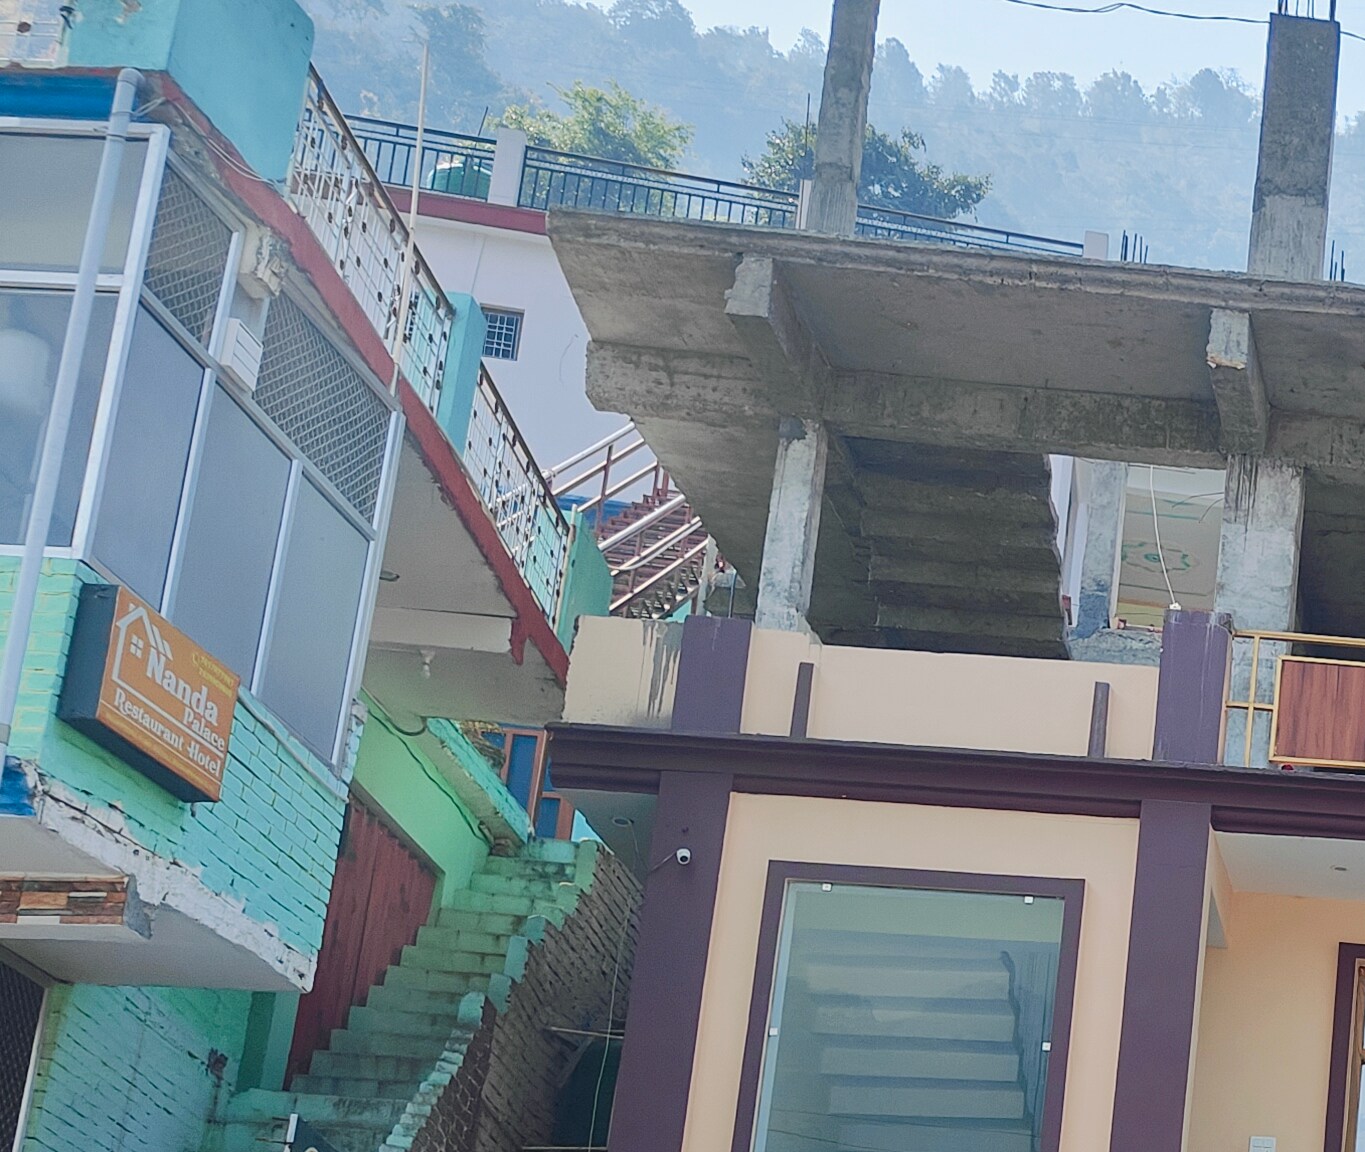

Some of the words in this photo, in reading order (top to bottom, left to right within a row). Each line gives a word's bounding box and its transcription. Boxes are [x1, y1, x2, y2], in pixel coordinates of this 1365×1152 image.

[146, 647, 218, 726] Nanda
[114, 688, 184, 751] Restaurant
[187, 741, 221, 778] Hotel
[183, 707, 225, 751] Palace
